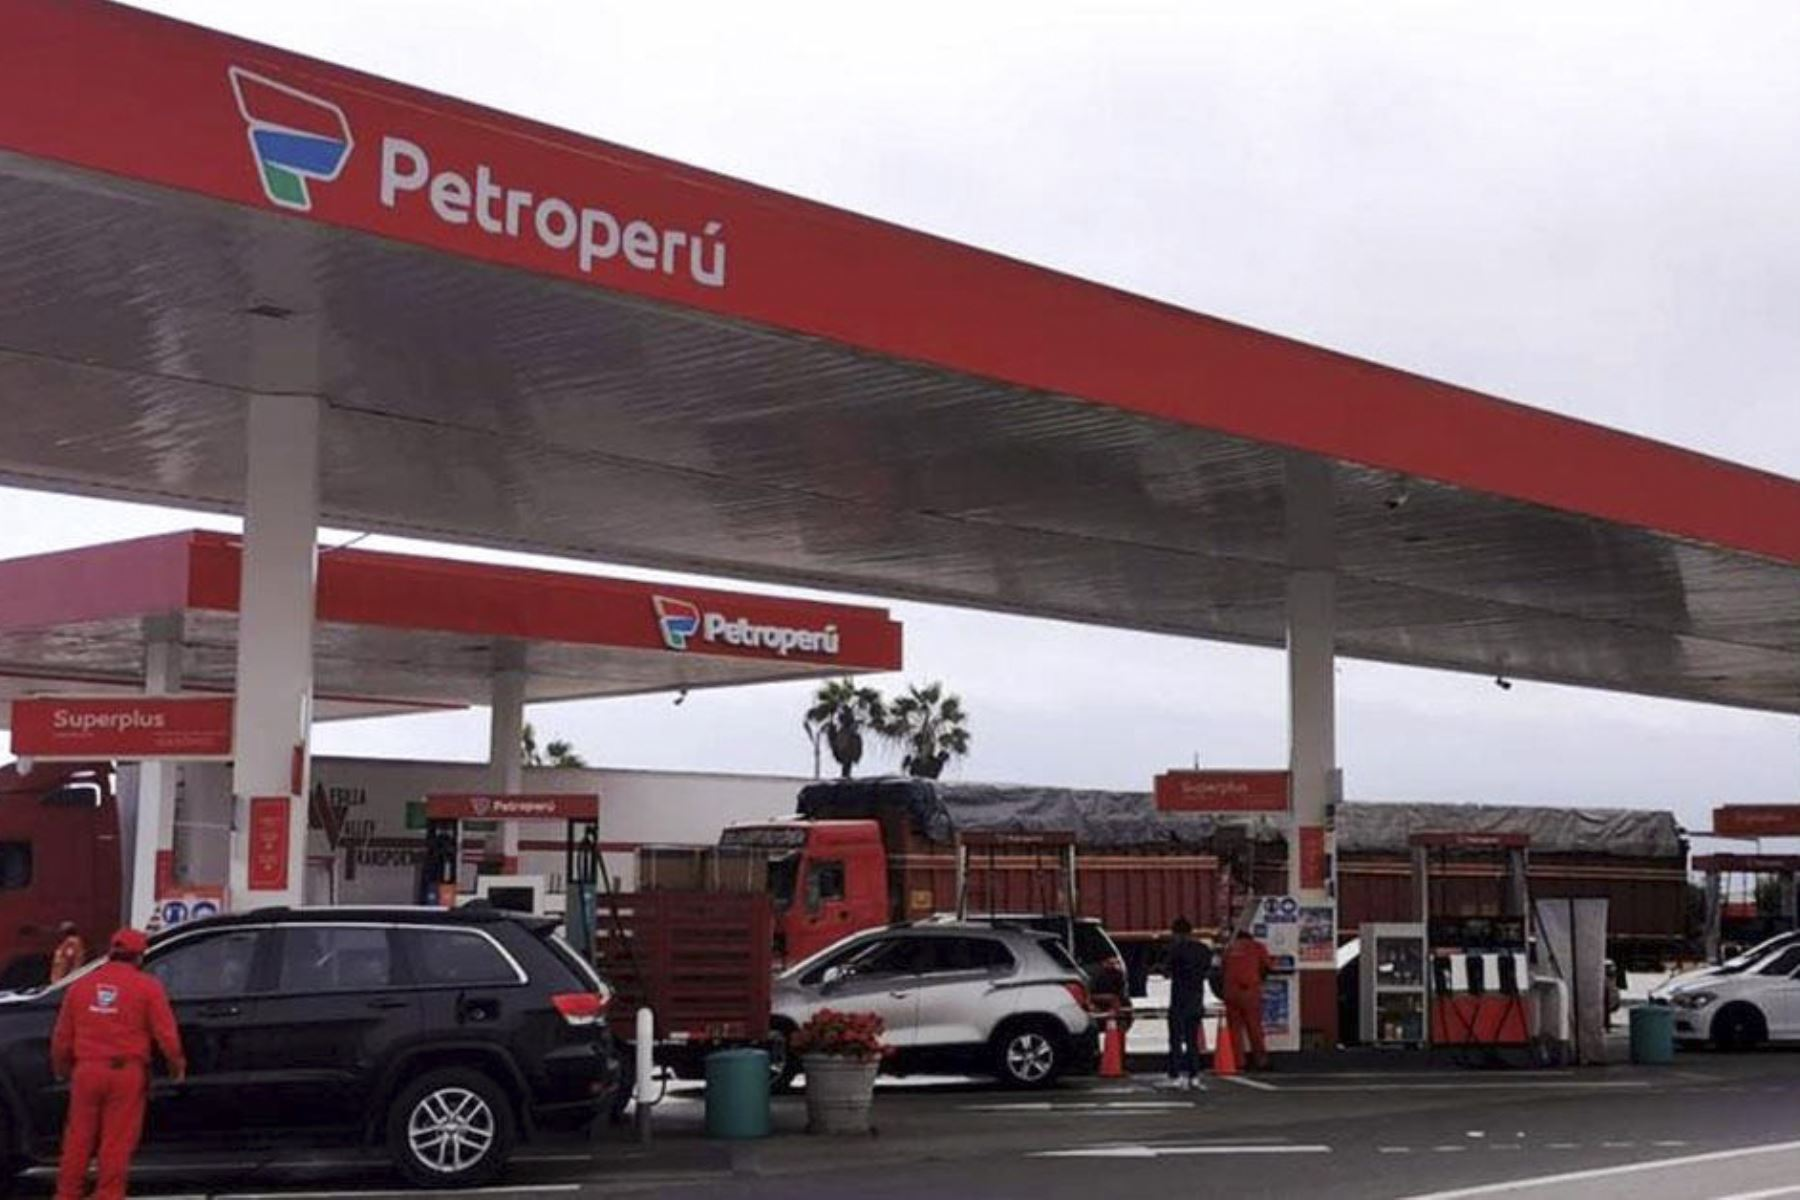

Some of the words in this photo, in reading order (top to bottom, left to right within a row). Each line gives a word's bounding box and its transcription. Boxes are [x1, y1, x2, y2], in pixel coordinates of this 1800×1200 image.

[379, 135, 726, 288] Petroperú
[703, 612, 839, 654] Petroperú
[53, 709, 165, 732] Superplus
